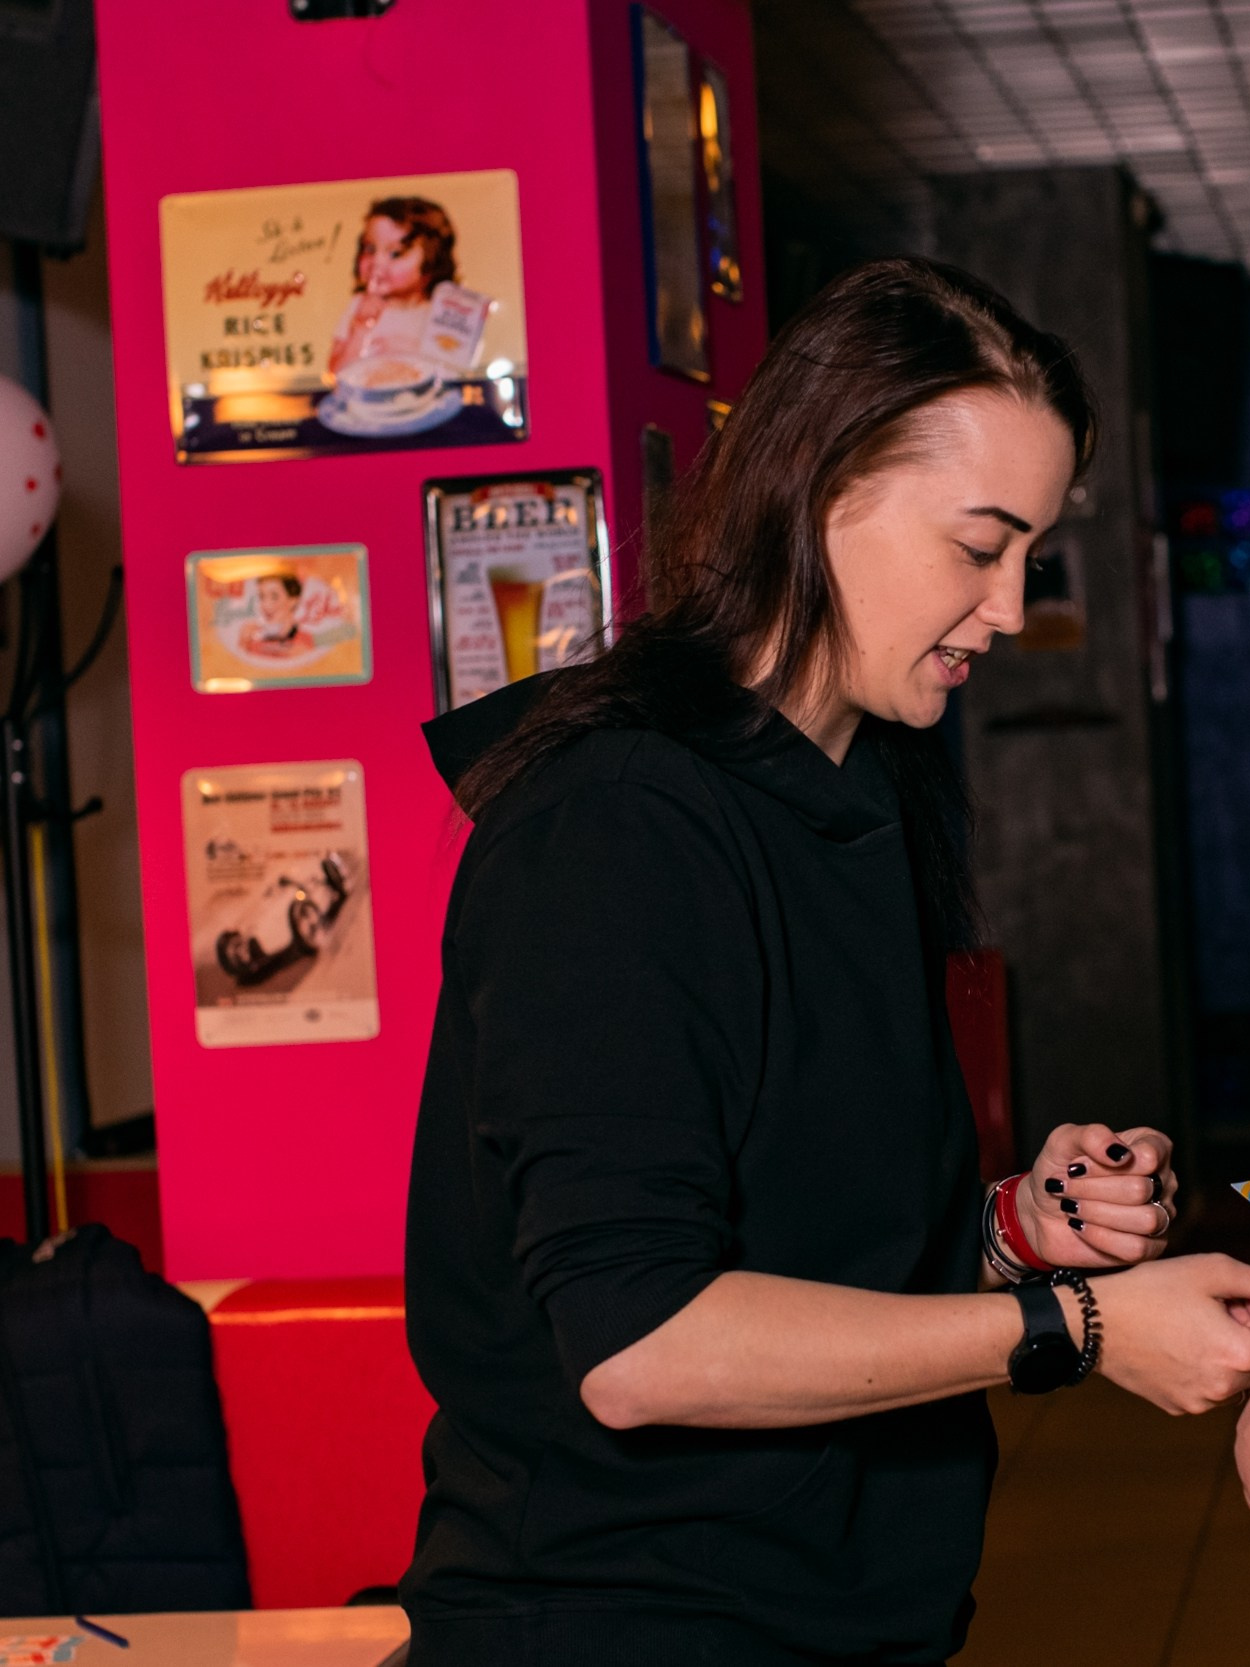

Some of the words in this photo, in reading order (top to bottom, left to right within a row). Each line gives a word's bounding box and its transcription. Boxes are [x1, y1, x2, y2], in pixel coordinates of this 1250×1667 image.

[224, 312, 285, 336] RICE
[200, 342, 315, 370] KRISPIES
[453, 497, 579, 531] BEER
